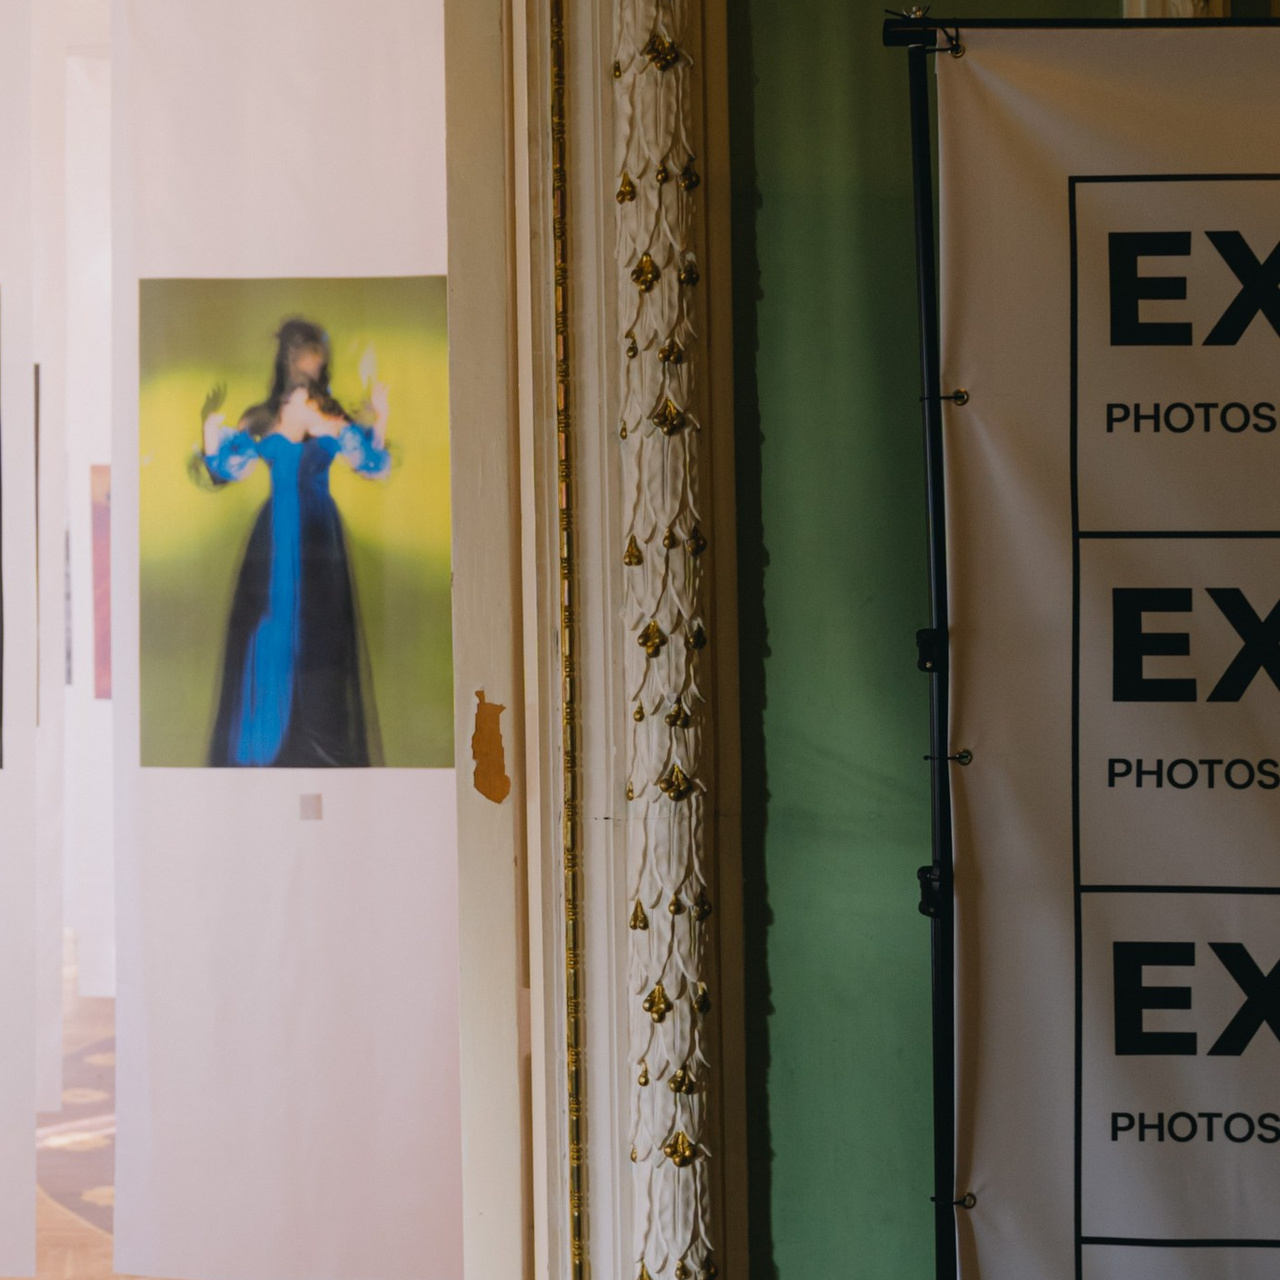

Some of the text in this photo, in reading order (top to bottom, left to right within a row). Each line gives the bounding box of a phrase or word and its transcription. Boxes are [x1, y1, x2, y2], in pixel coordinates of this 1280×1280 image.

[1106, 401, 1277, 434] PHOTOS
[1108, 758, 1280, 790] PHOTOS
[1111, 1111, 1280, 1144] PHOTOS
